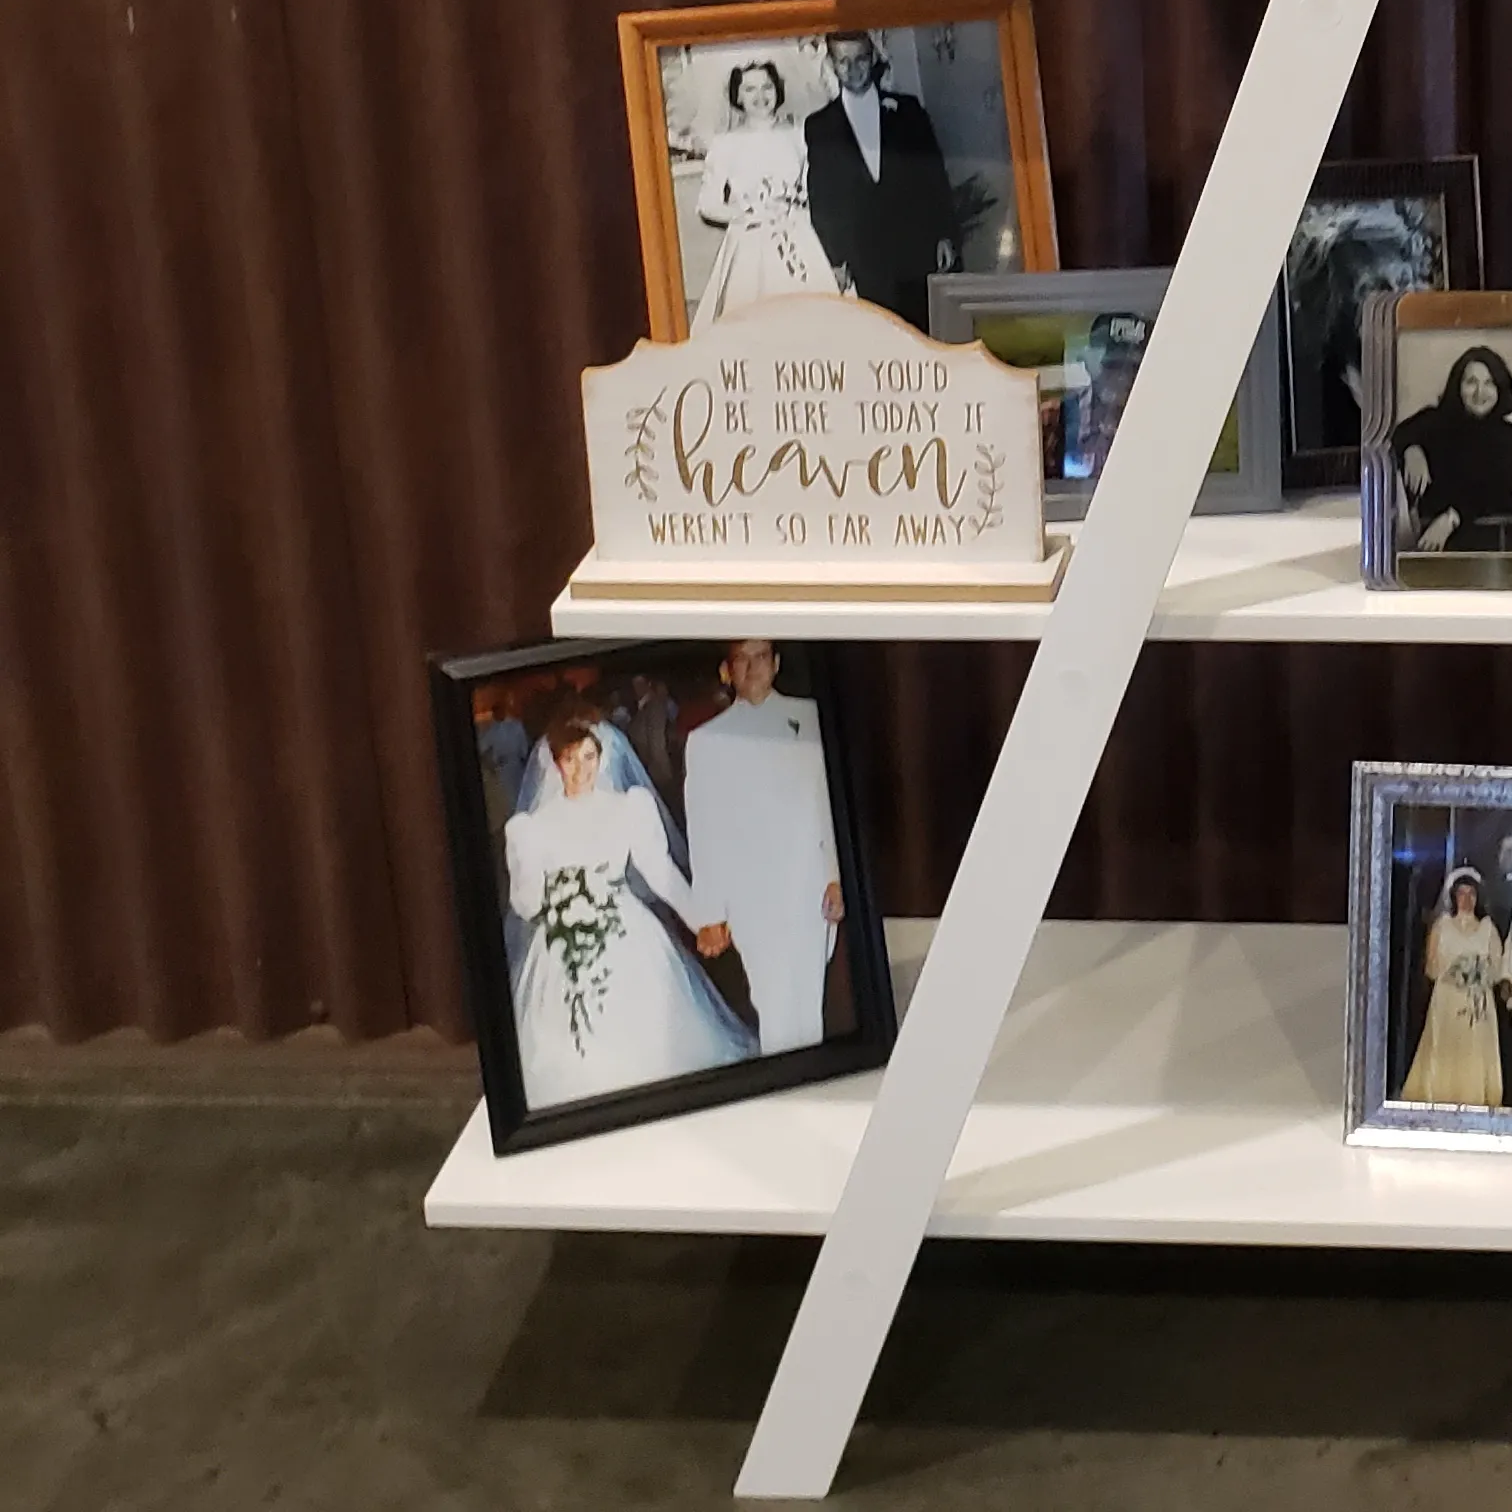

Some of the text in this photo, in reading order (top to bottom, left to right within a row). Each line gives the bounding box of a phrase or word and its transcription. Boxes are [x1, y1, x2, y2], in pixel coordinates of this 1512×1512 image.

[720, 359, 948, 392] WE KNOW YOU'D
[725, 400, 986, 434] BE HERE TODAY IF
[673, 378, 967, 509] heaven
[648, 512, 965, 547] WEREN'T SO FAR AWAY
